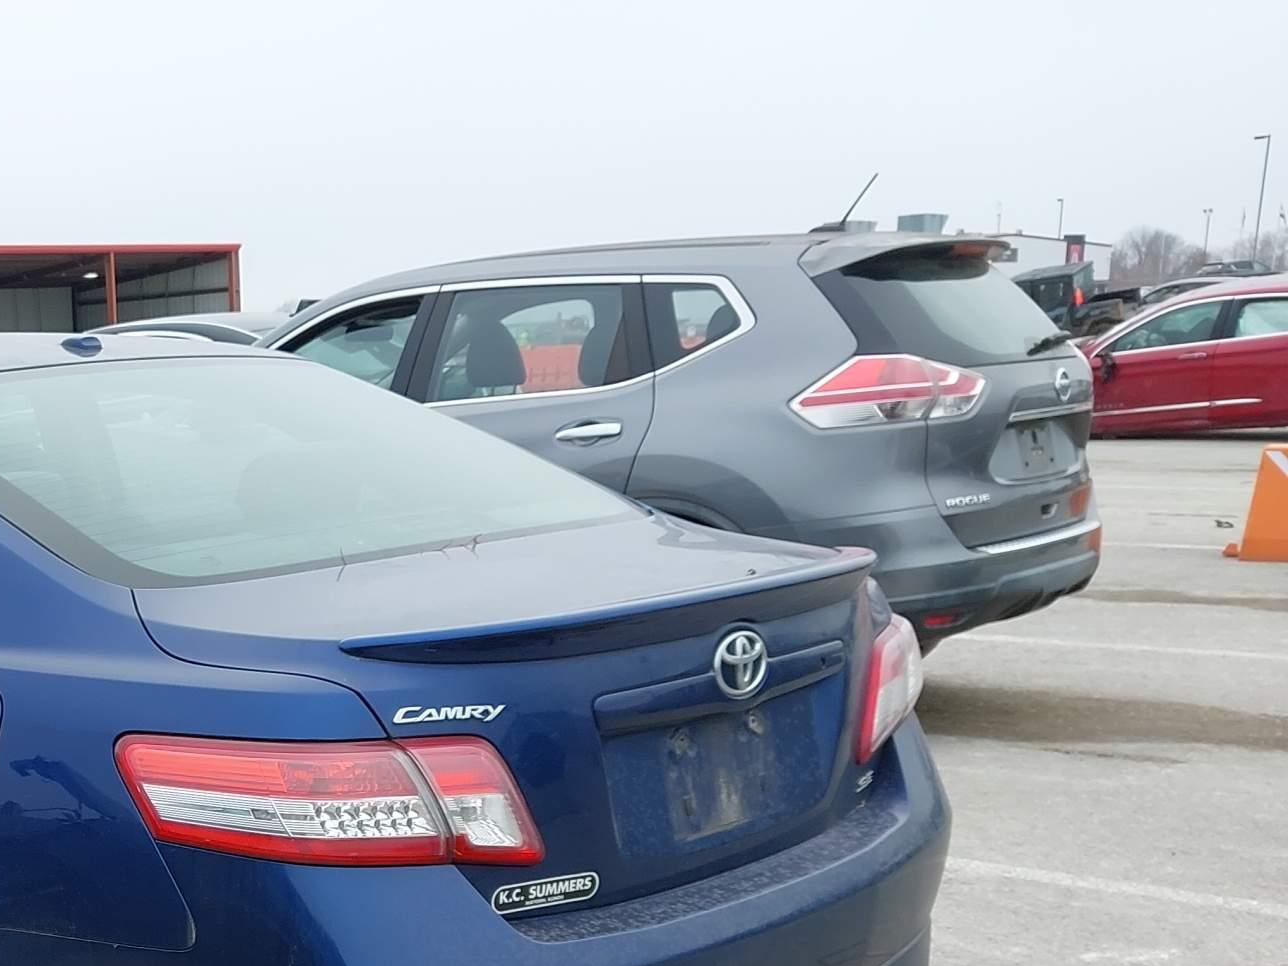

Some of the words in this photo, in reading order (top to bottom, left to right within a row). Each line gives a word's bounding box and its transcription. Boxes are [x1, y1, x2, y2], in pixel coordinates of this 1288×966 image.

[945, 493, 991, 507] ROGUE
[392, 704, 506, 724] CAMRY
[499, 889, 524, 905] K.C.
[528, 876, 593, 899] SUMMERS
